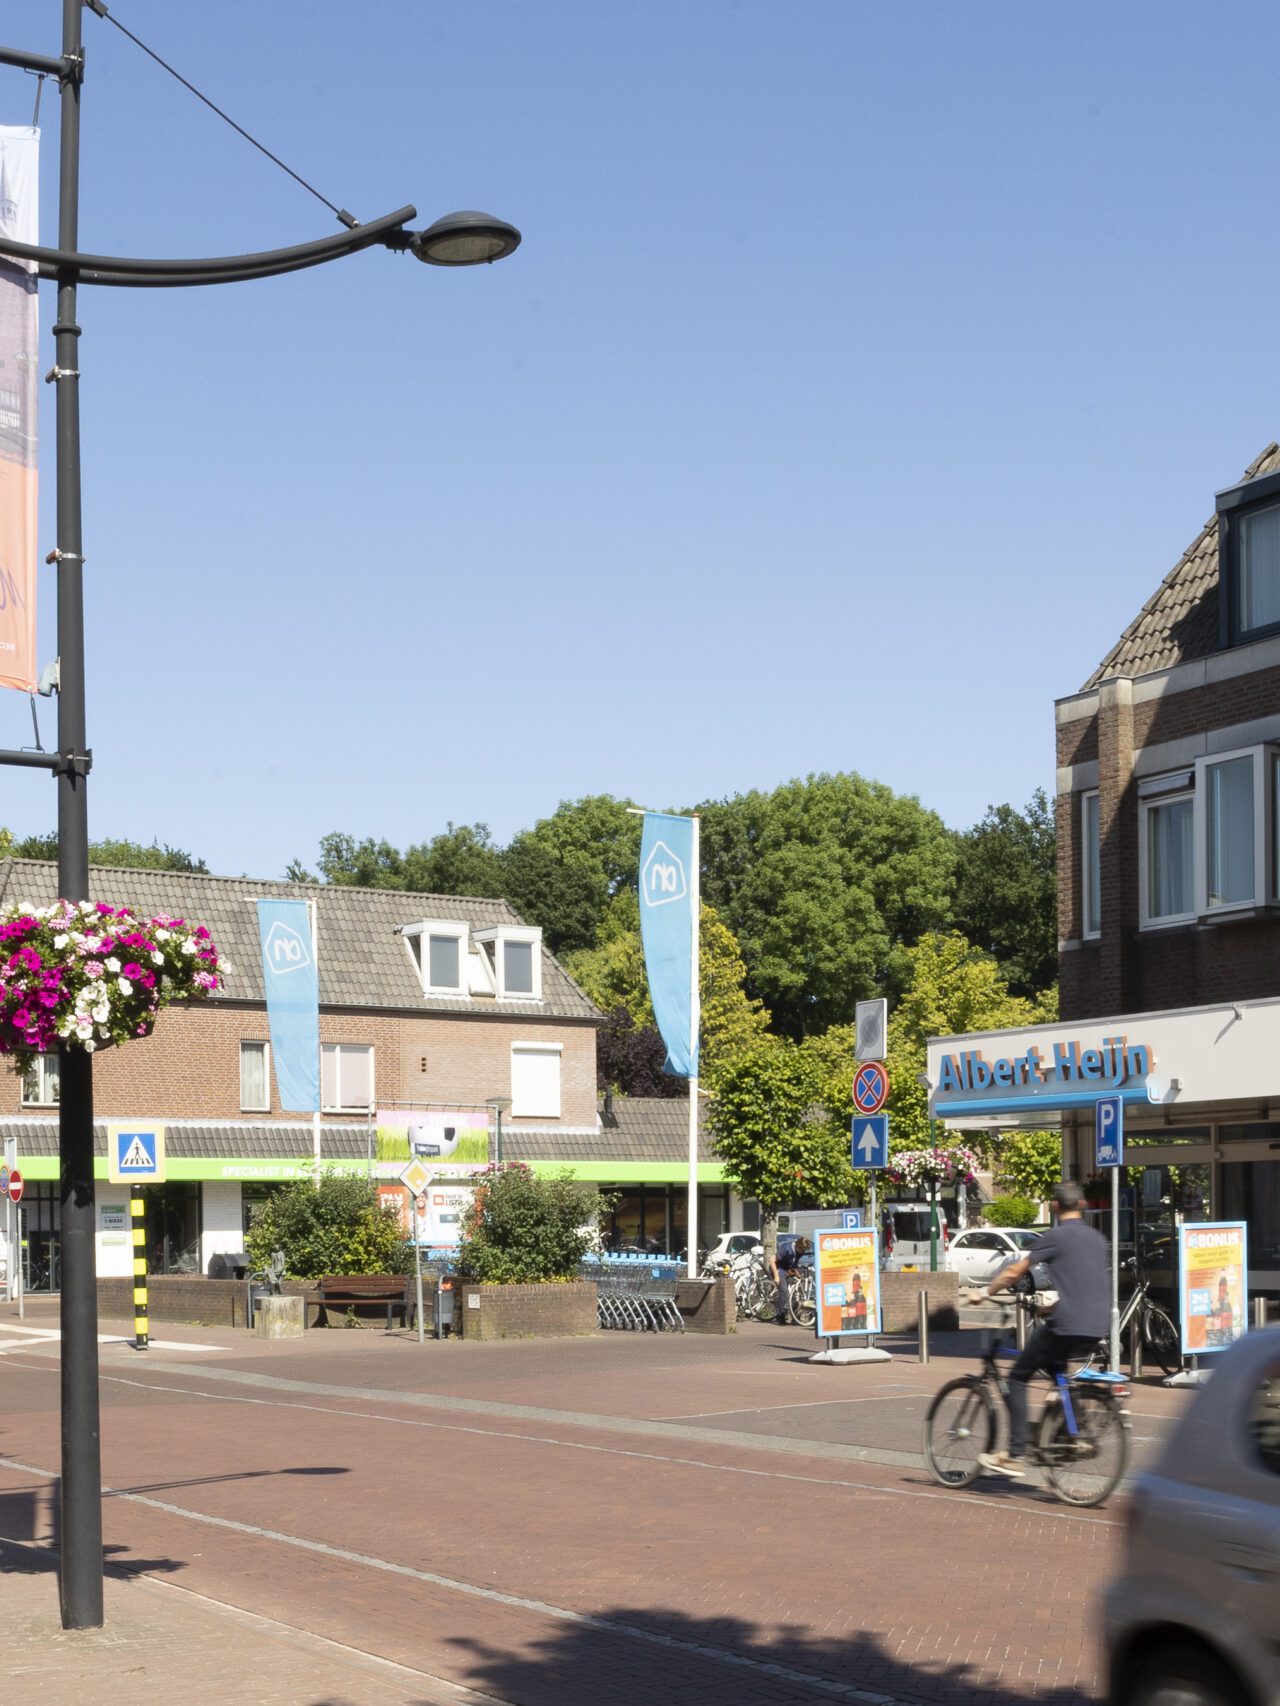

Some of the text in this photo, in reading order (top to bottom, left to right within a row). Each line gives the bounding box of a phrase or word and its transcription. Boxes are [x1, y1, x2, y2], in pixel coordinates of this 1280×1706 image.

[939, 1036, 1153, 1092] Albert Heijn
[1101, 1104, 1114, 1138] P
[221, 1166, 280, 1177] SPECIALIST
[283, 1167, 295, 1178] IN
[832, 1237, 871, 1250] BONUS
[1197, 1232, 1239, 1248] BONUS
